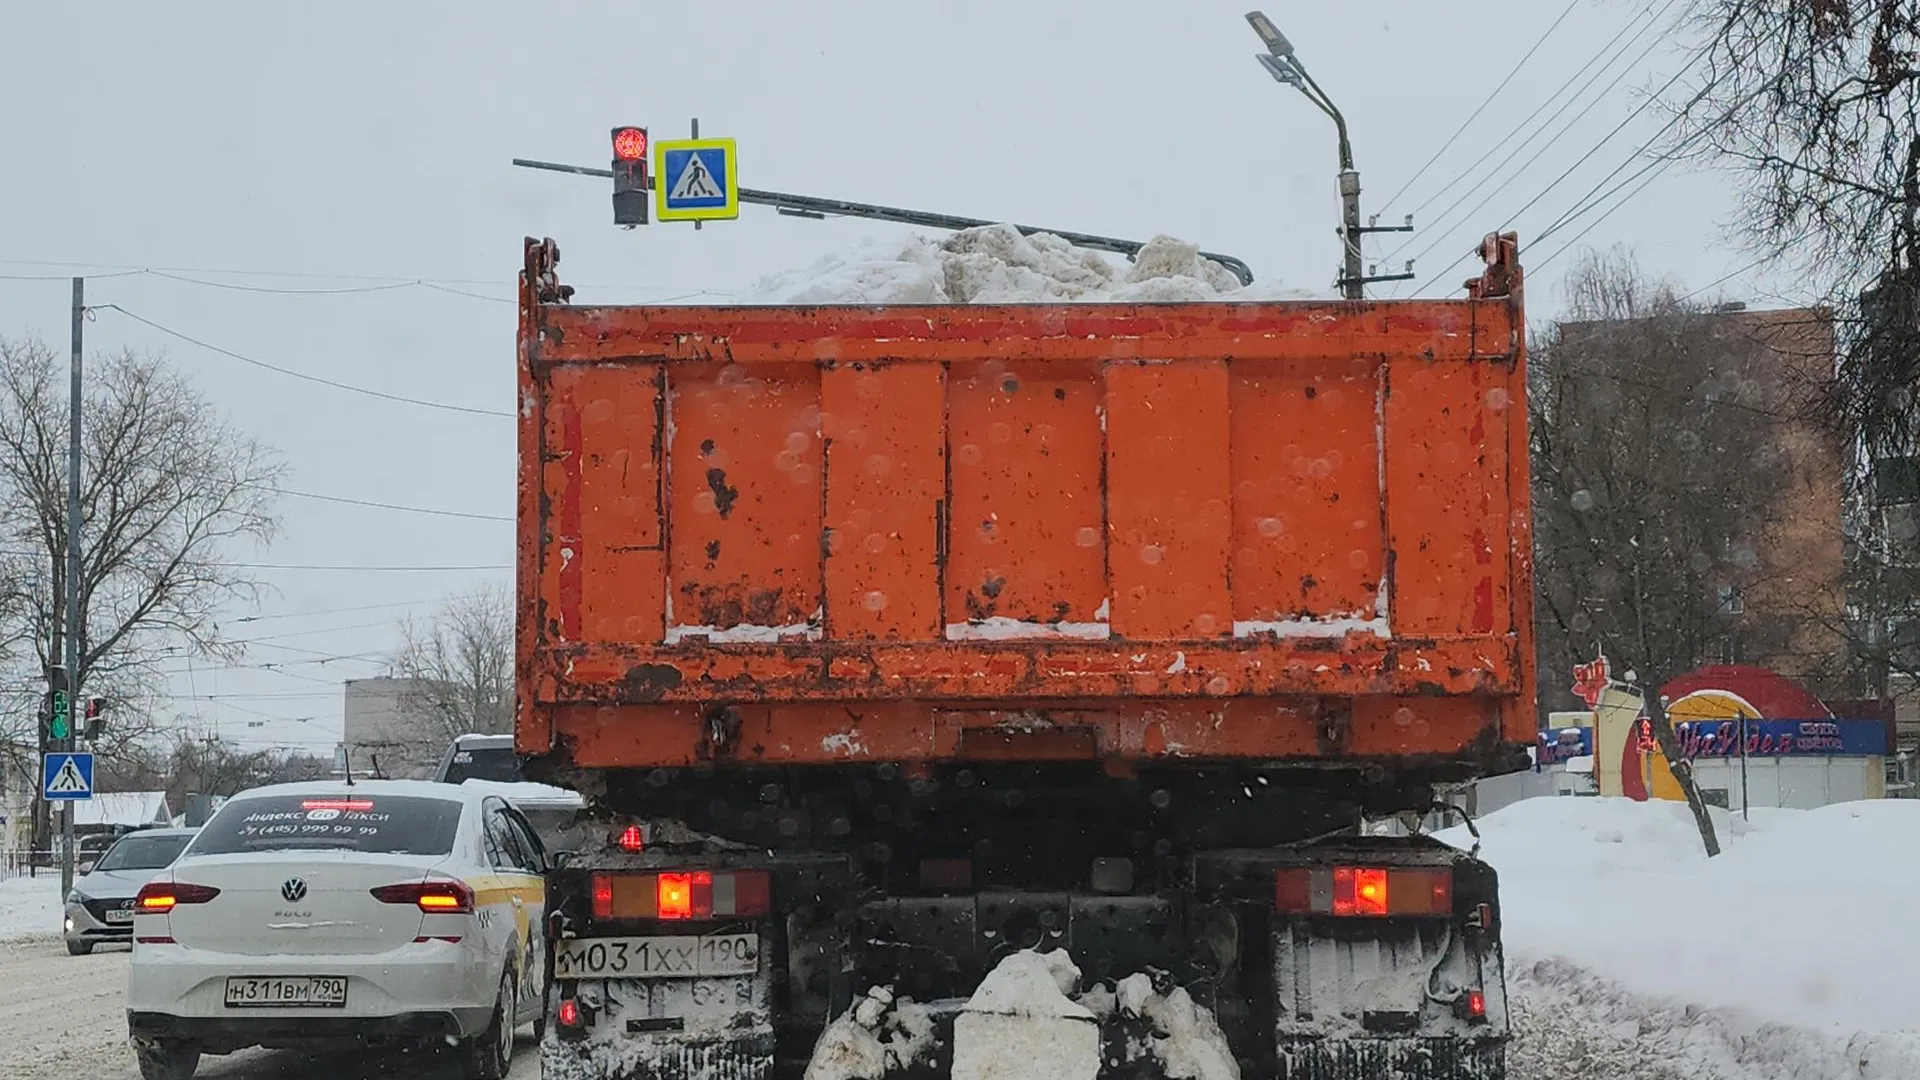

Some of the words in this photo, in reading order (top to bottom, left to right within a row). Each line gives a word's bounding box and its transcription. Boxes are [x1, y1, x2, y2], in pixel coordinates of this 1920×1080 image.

[302, 824, 329, 834] 999
[333, 824, 352, 834] 99
[359, 826, 378, 836] 99
[704, 937, 749, 962] 190
[312, 979, 341, 994] 790
